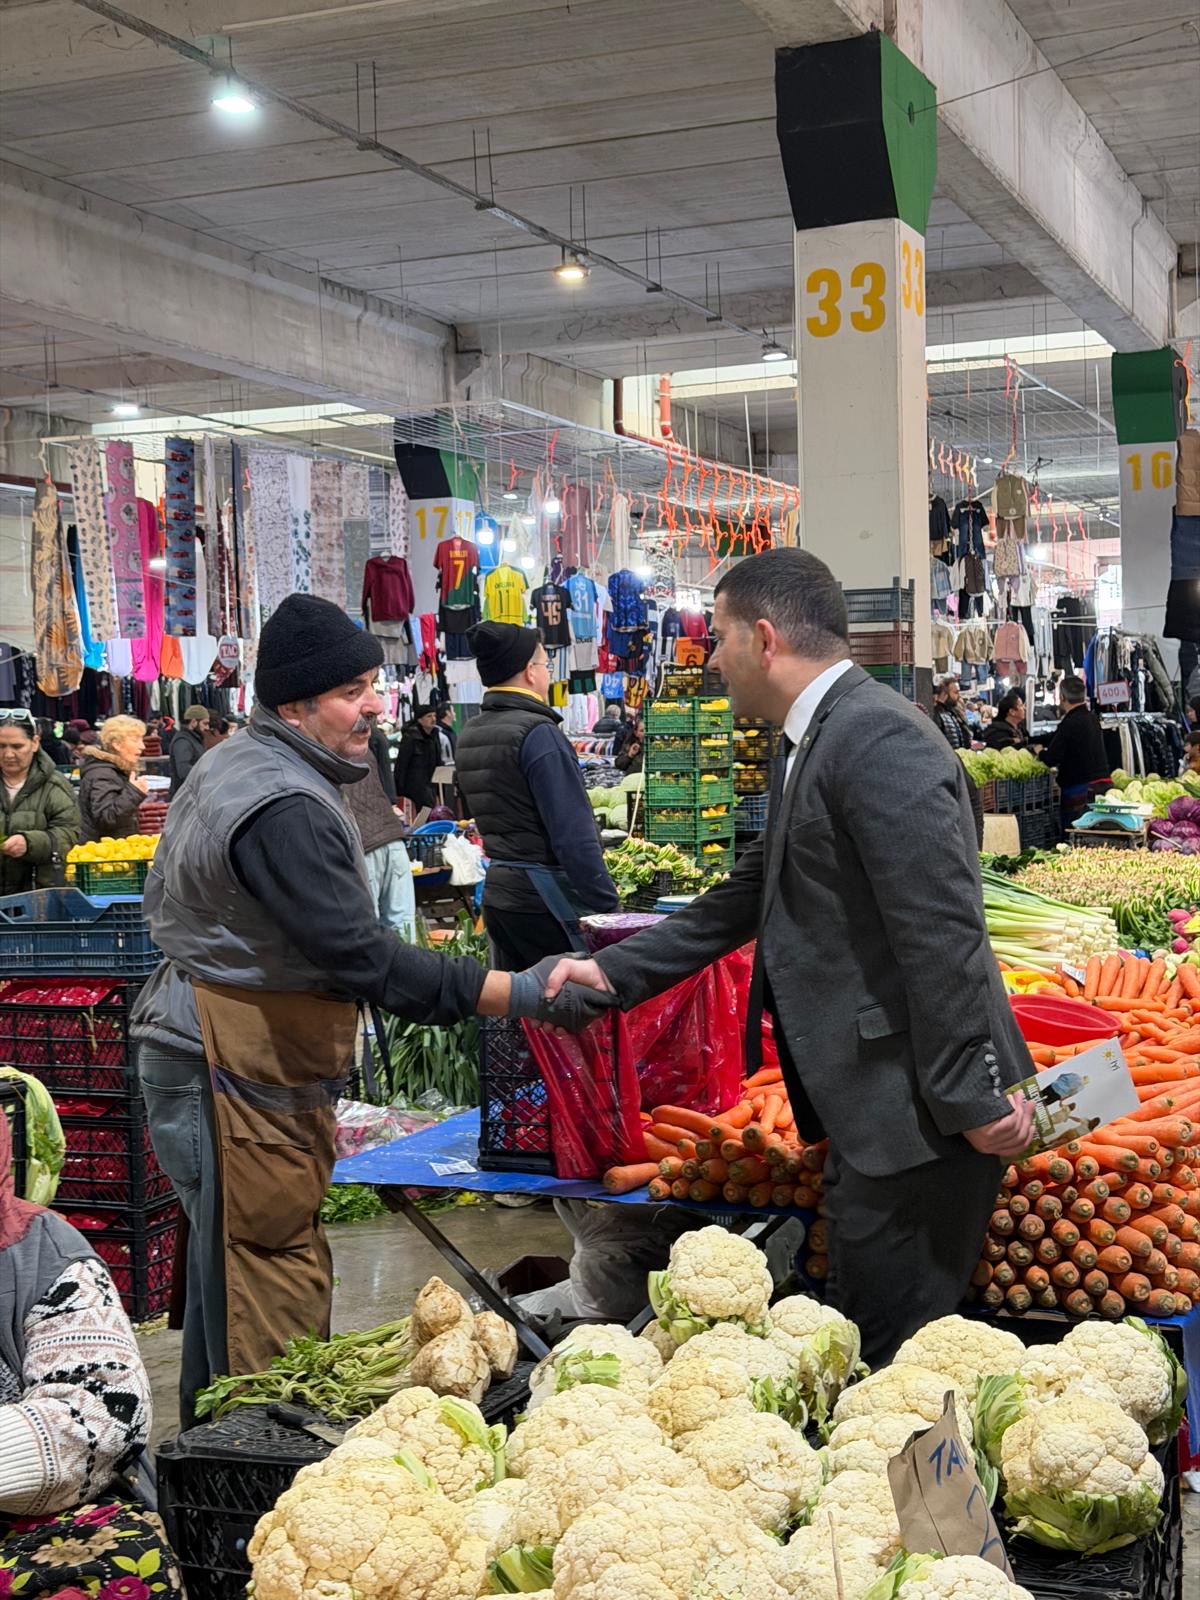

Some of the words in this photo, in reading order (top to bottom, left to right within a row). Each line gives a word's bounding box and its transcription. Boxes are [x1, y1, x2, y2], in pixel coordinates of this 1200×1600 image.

[902, 240, 924, 317] 33
[805, 262, 887, 338] 33
[1125, 451, 1172, 491] 16
[415, 506, 449, 540] 17
[453, 560, 465, 590] 7
[541, 601, 562, 626] 45
[574, 591, 589, 613] 31
[1102, 687, 1120, 698] 400
